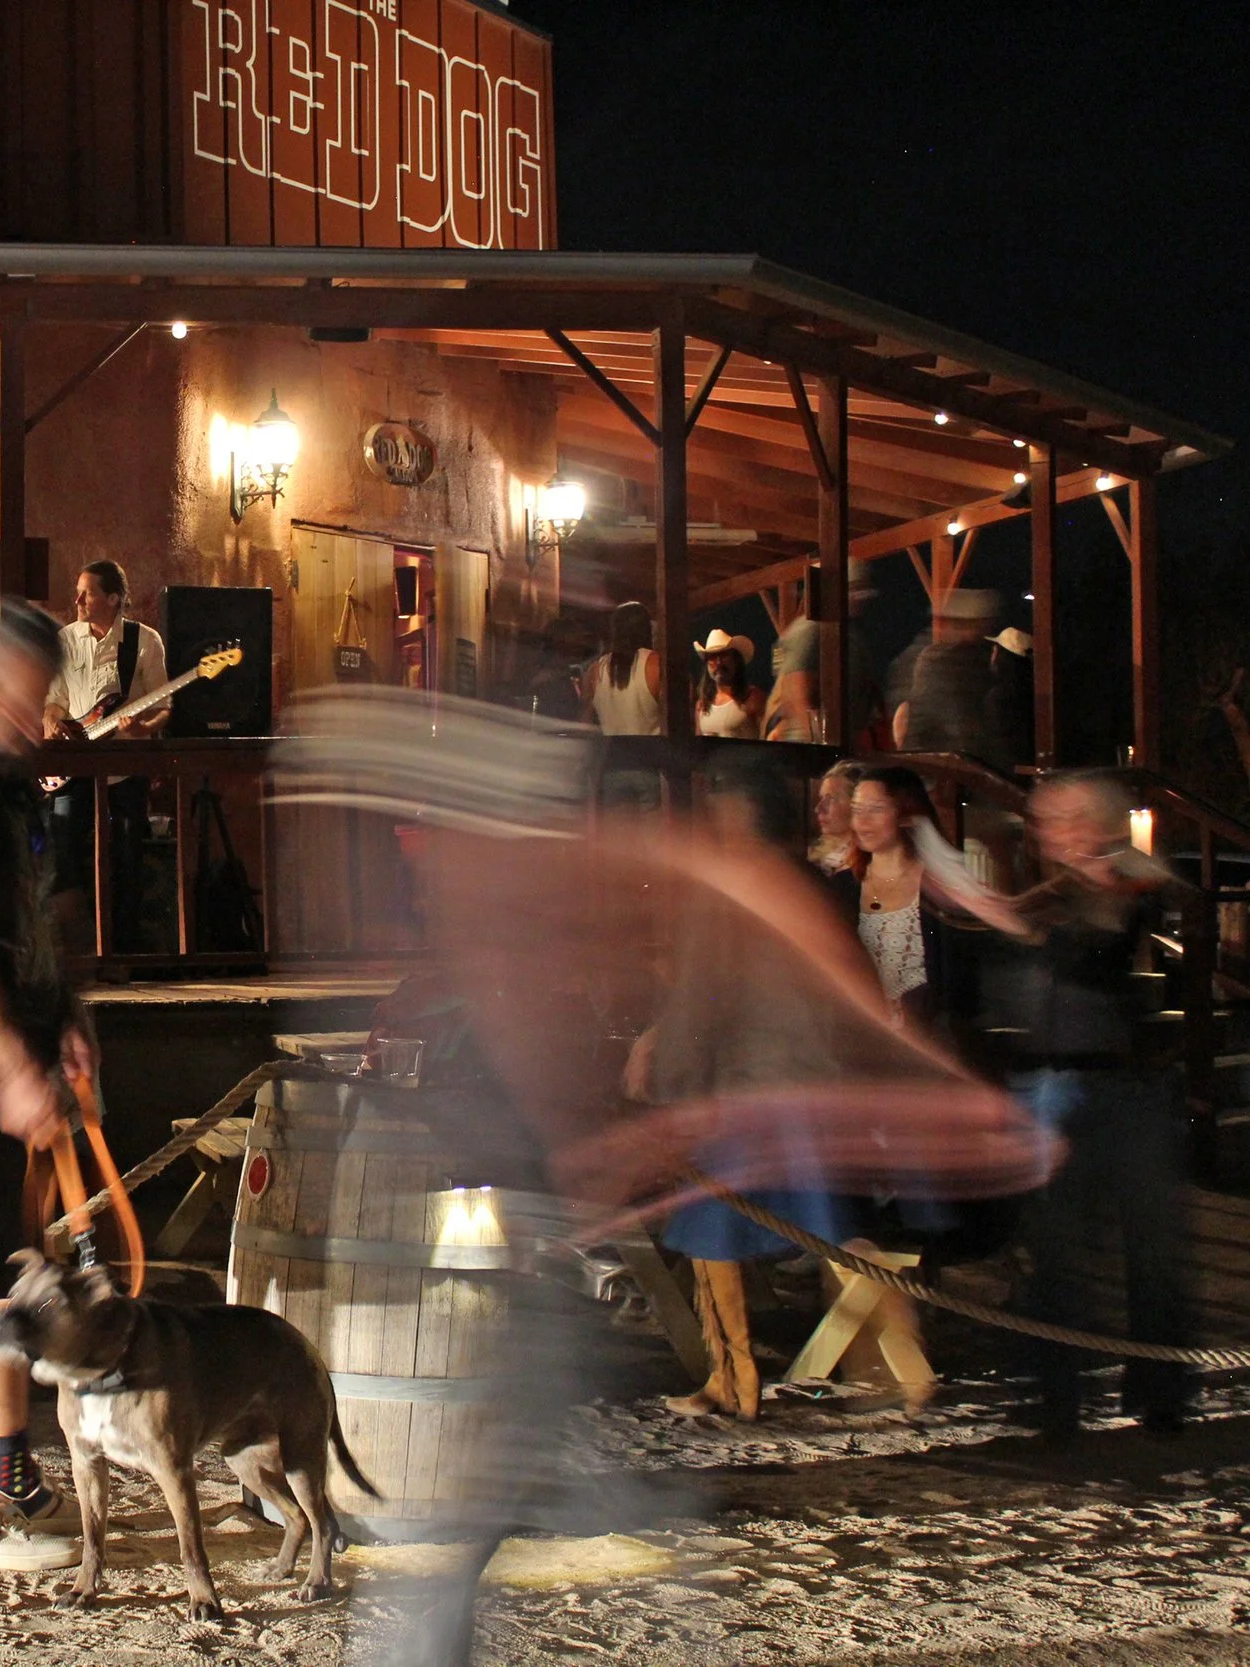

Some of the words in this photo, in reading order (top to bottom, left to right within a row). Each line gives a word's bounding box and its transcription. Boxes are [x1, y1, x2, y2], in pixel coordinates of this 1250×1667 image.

[193, 0, 380, 210] RED
[396, 29, 541, 250] DOG
[340, 651, 360, 668] OPEN
